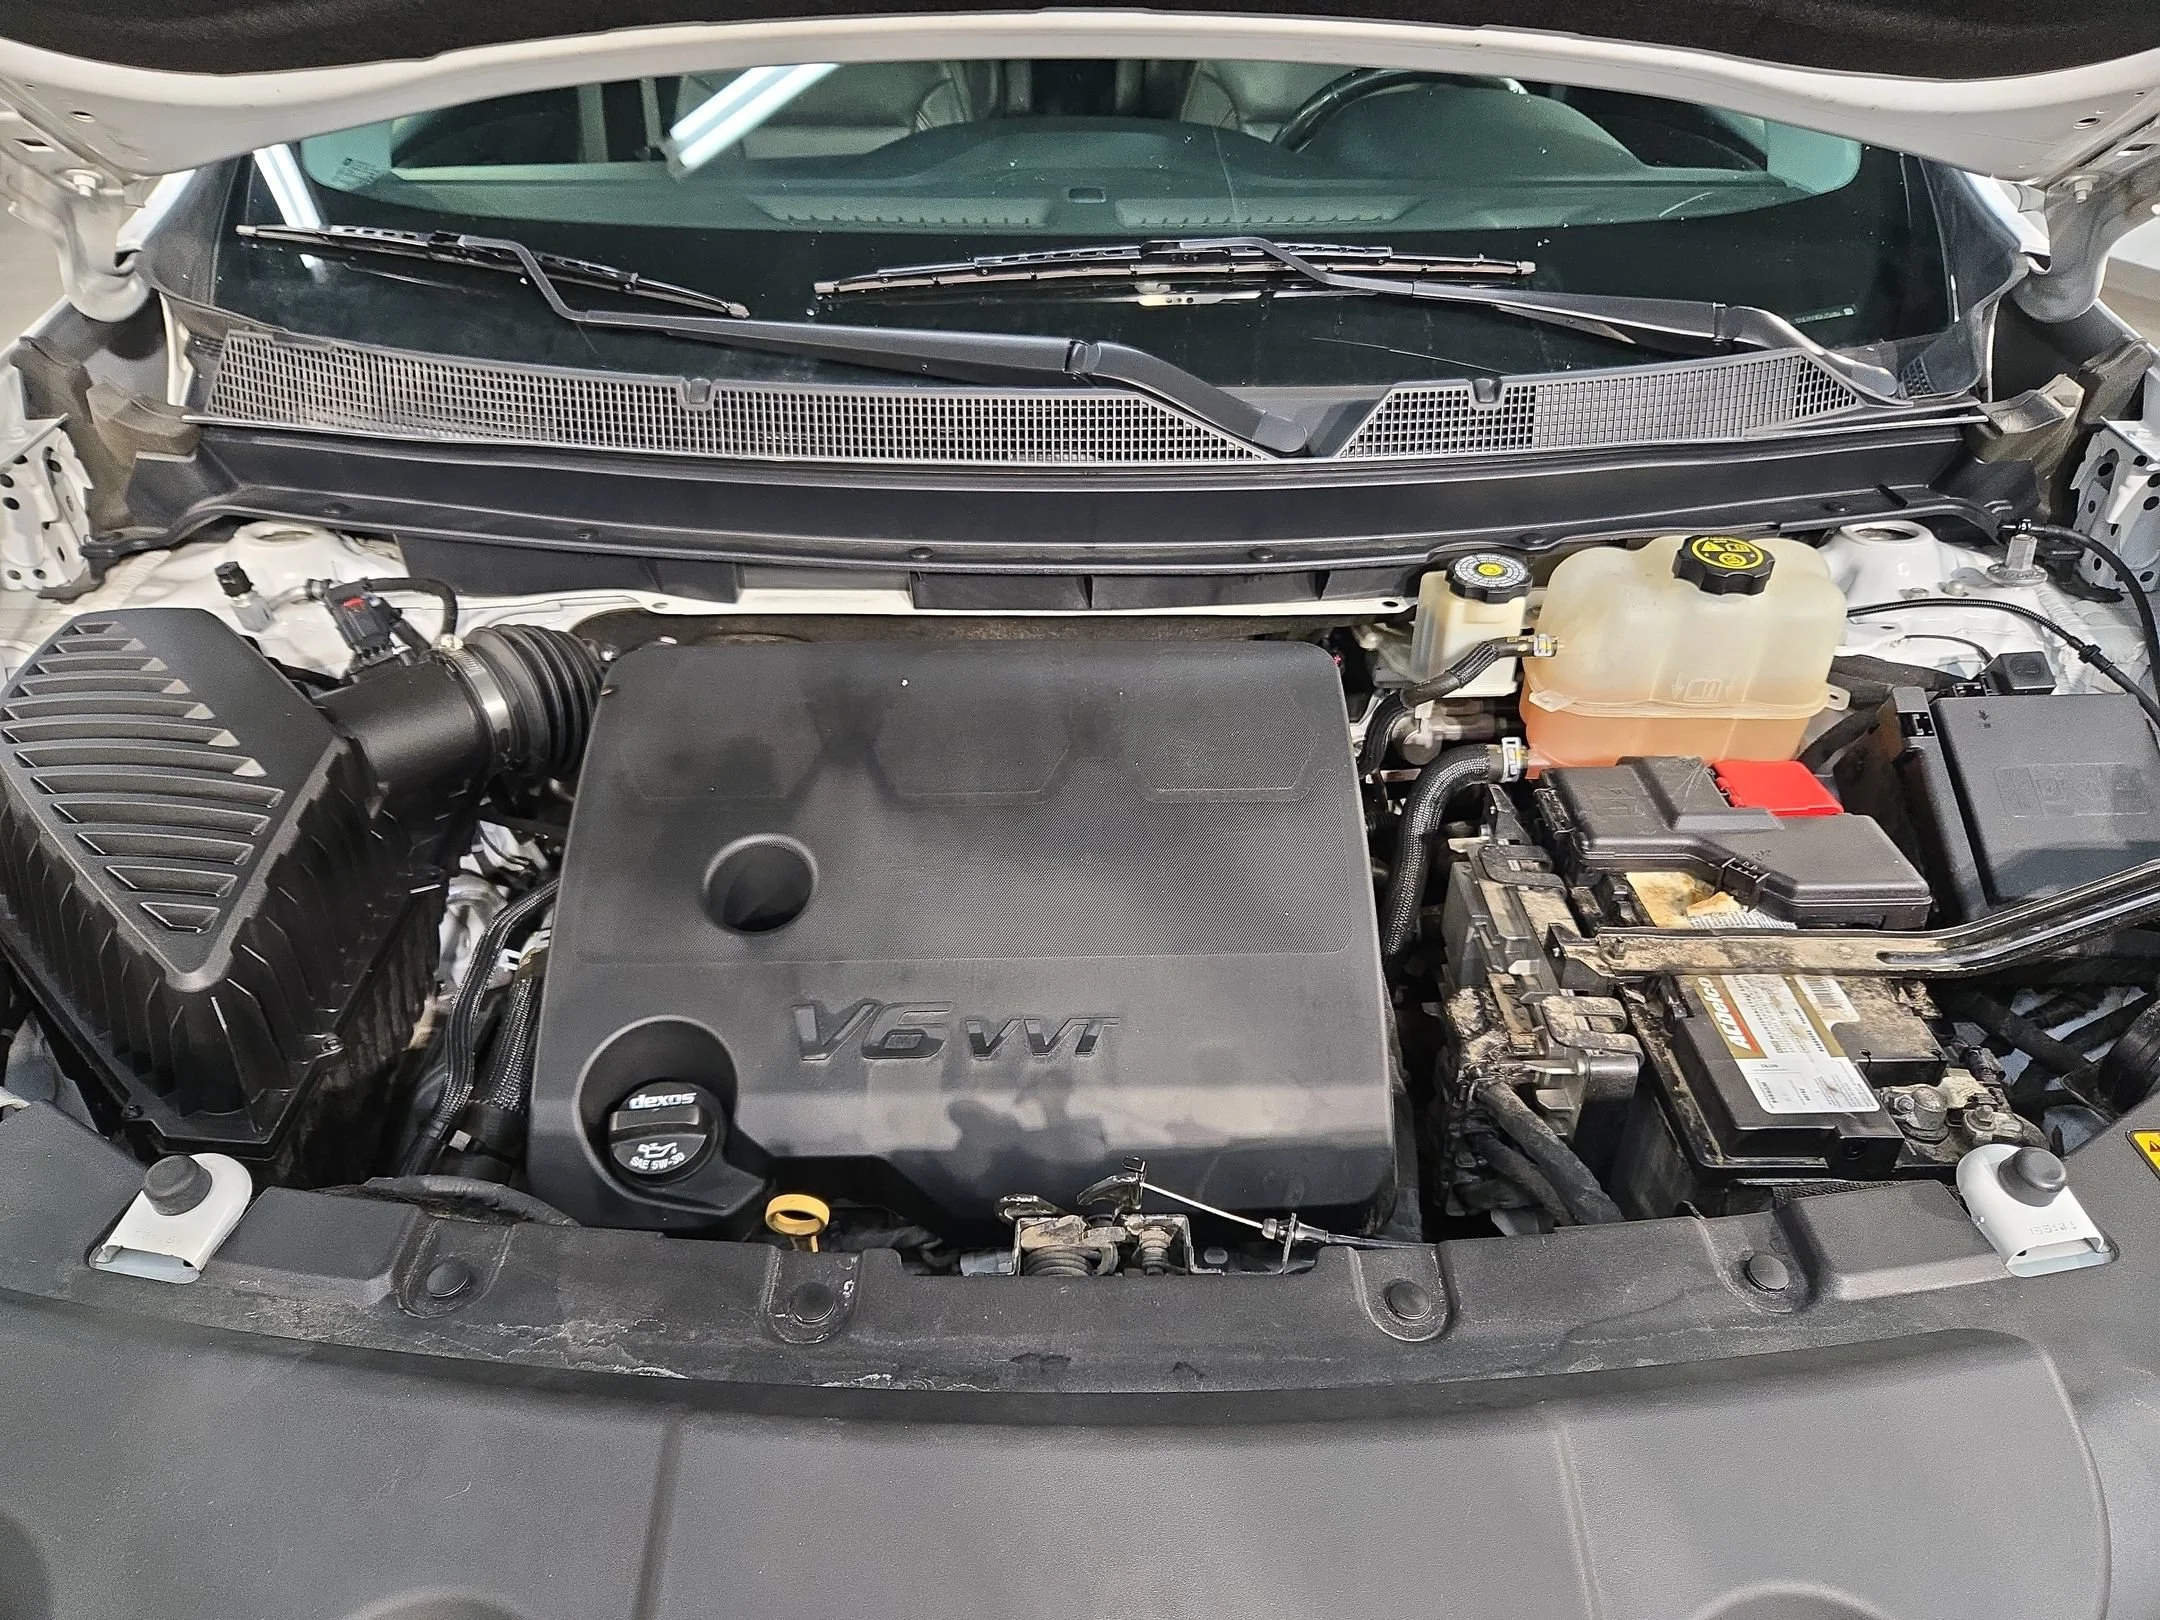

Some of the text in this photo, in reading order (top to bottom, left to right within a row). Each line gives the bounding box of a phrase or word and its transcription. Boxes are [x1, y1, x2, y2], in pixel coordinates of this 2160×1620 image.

[790, 999, 1121, 1062] V6 VVT
[1697, 976, 1752, 1051] ACDelco
[628, 1092, 698, 1110] dexos
[629, 1152, 685, 1171] SAE 5W-30
